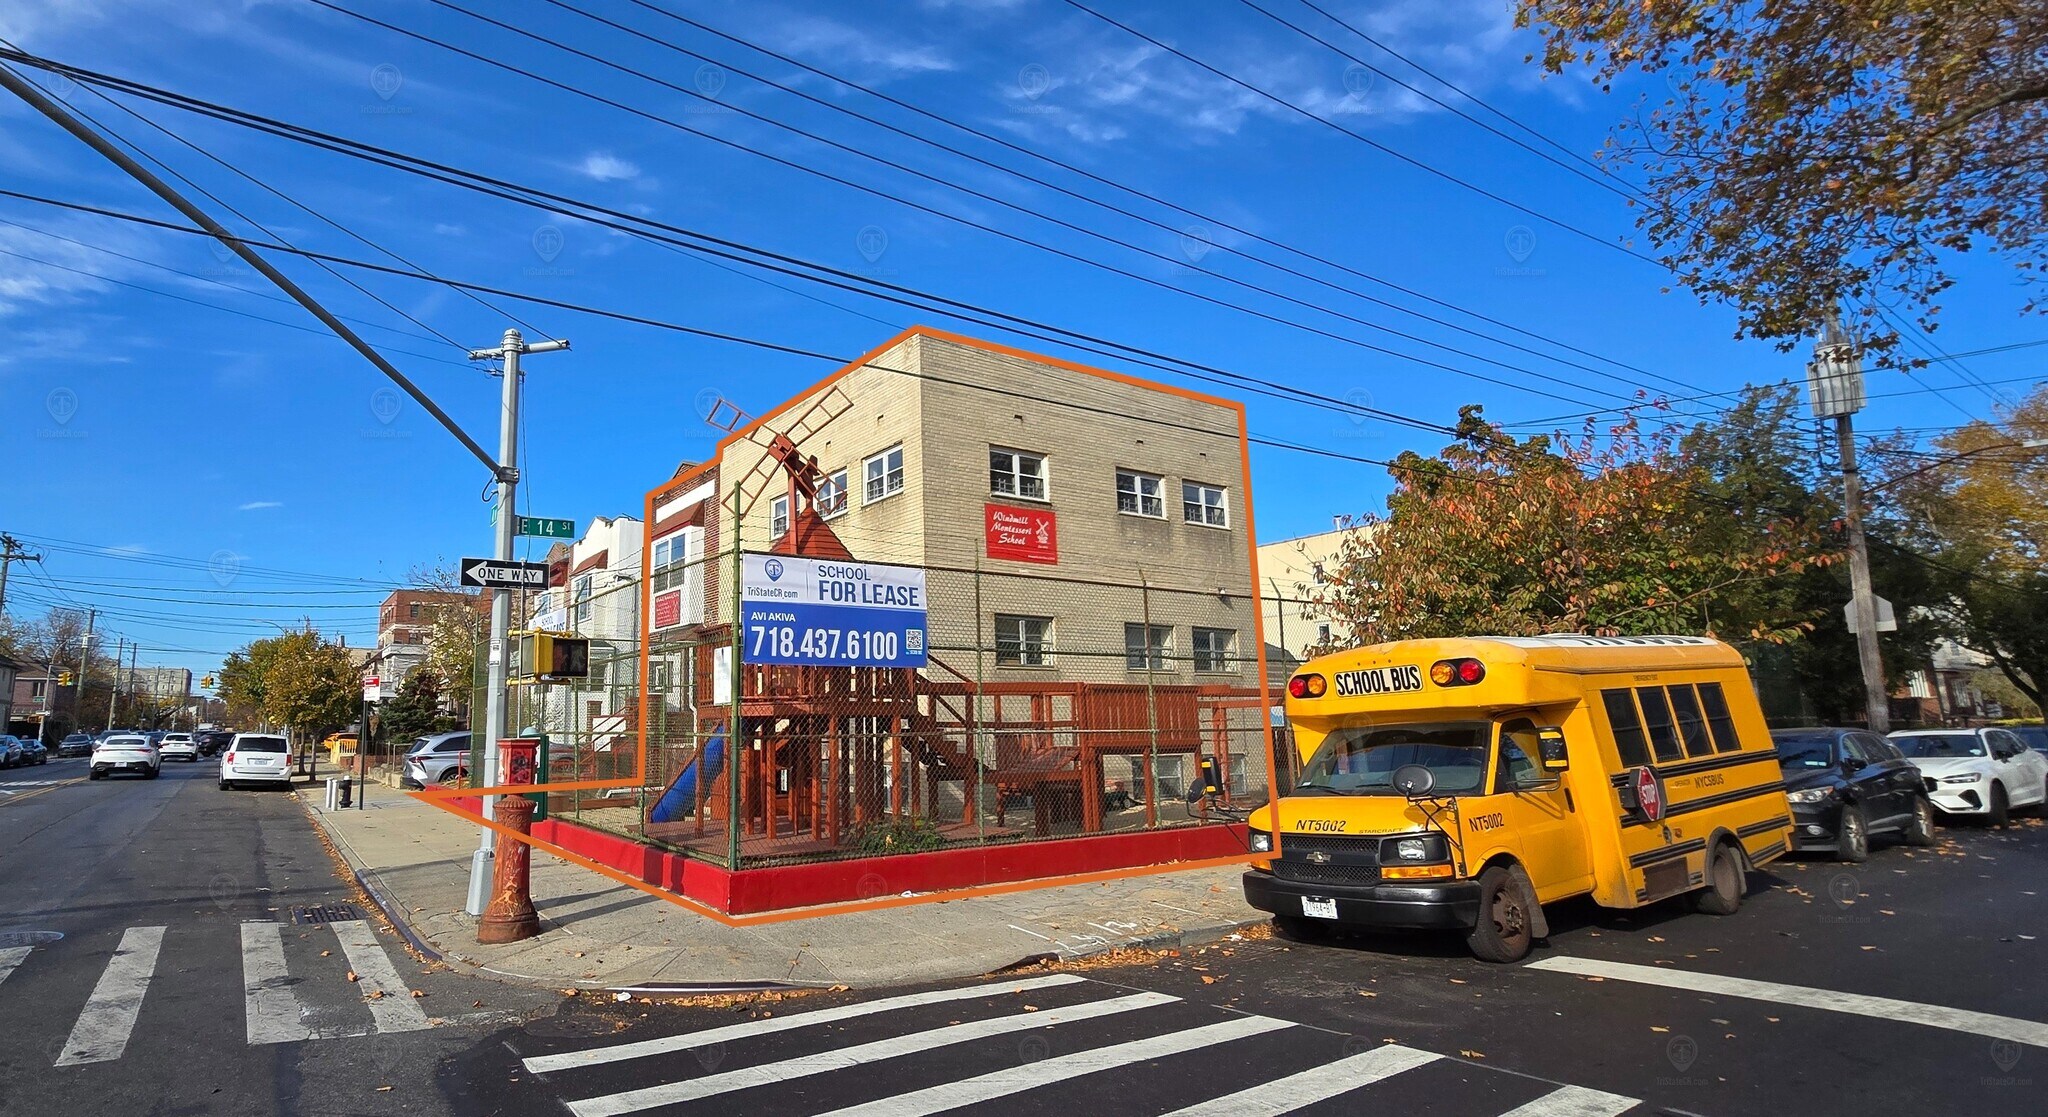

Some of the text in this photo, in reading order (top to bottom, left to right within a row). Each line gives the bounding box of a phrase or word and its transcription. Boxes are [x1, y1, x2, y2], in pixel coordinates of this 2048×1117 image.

[993, 511, 1028, 525] Windmill
[521, 518, 528, 534] E
[538, 520, 554, 535] 14
[990, 522, 1032, 535] Montessori
[998, 533, 1026, 545] School
[478, 567, 538, 582] ONE WAY
[818, 564, 871, 581] SCHOOL
[747, 587, 799, 600] TriStateCR.com
[818, 580, 920, 607] FOR LEASE
[751, 611, 796, 622] AVI AKIVA
[751, 625, 898, 661] 718.437.6100
[1336, 665, 1421, 696] SCHOOL BUS
[1694, 773, 1725, 788] NYCSBUS
[1641, 784, 1656, 804] STOP
[1296, 820, 1347, 832] NT5002
[1469, 812, 1504, 832] NT5002
